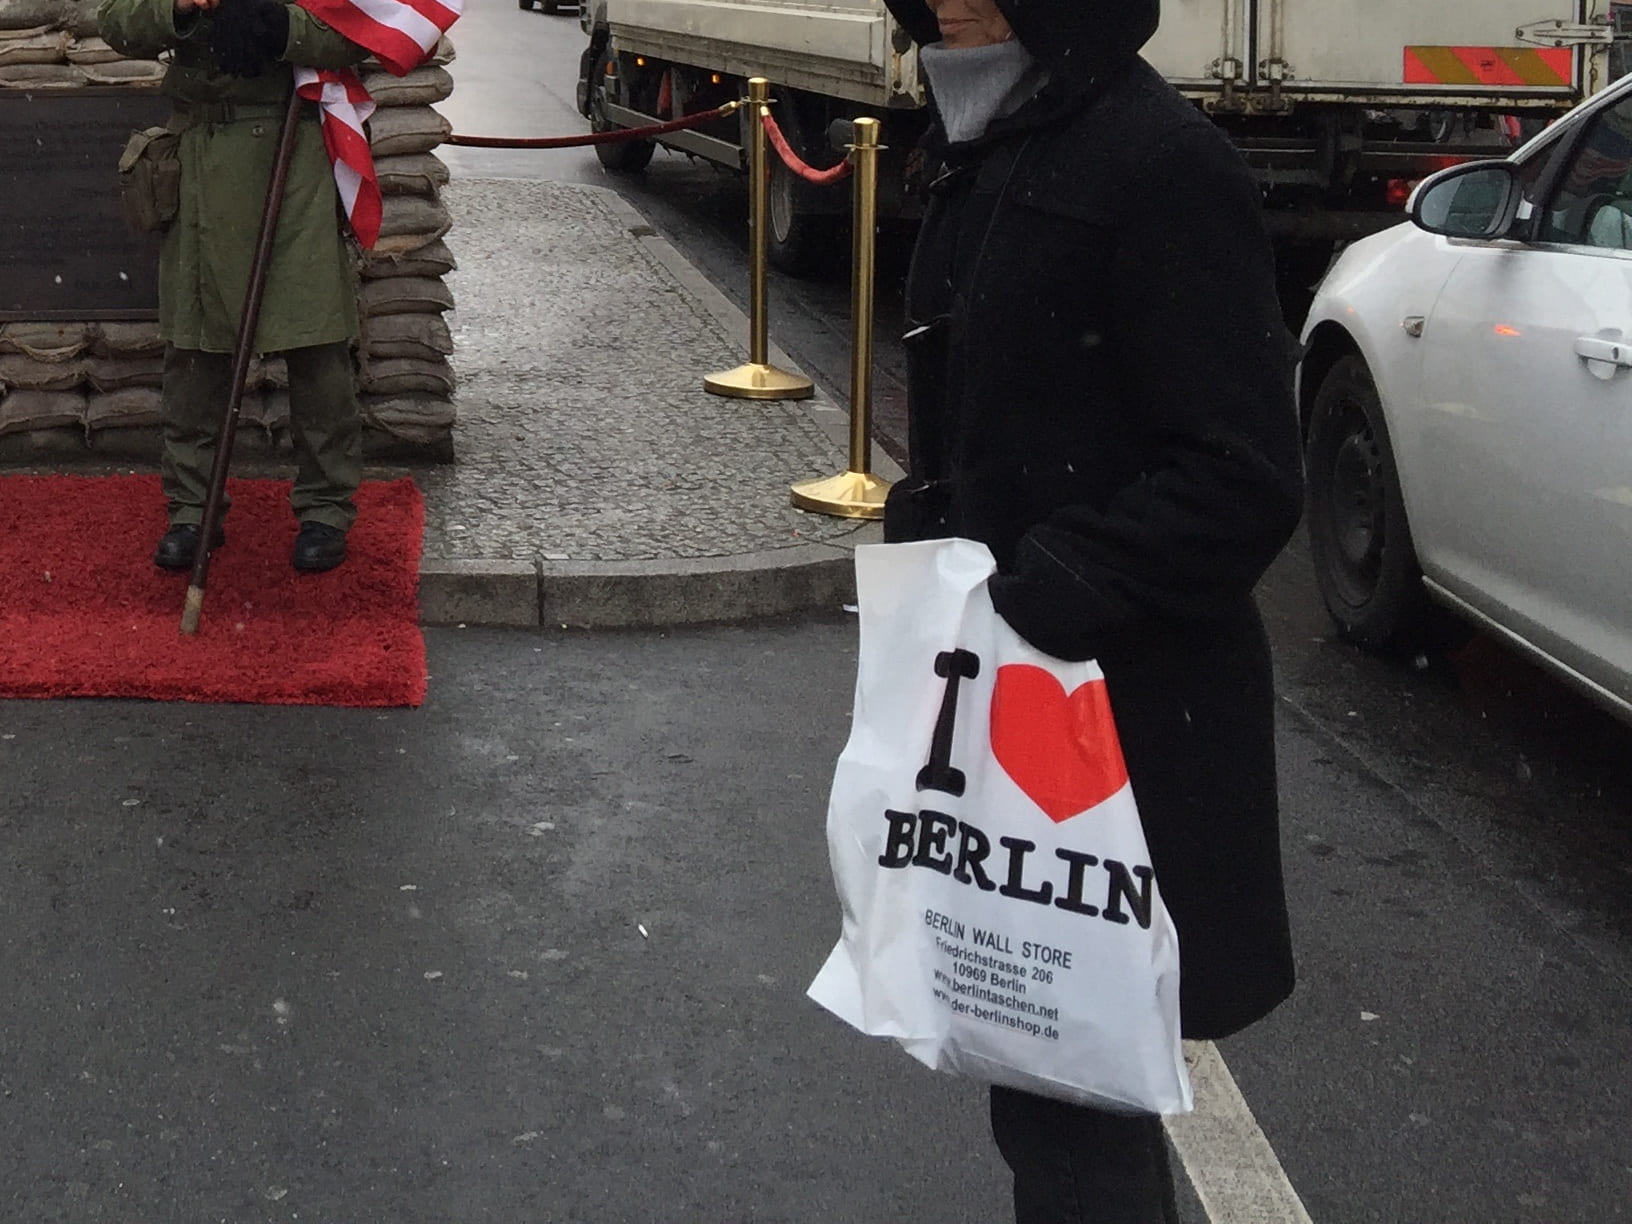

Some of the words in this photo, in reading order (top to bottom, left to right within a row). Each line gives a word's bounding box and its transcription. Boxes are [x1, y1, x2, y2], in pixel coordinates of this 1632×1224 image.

[915, 647, 981, 797] I
[878, 809, 1154, 930] BERLIN
[925, 909, 965, 940] BERLIN
[973, 927, 1013, 954] WALL
[1022, 941, 1073, 969] STORE
[936, 937, 1027, 977] Friedrichstrasse
[1031, 966, 1054, 984] 206
[952, 962, 987, 982] 10969
[990, 973, 1027, 994] Berlin
